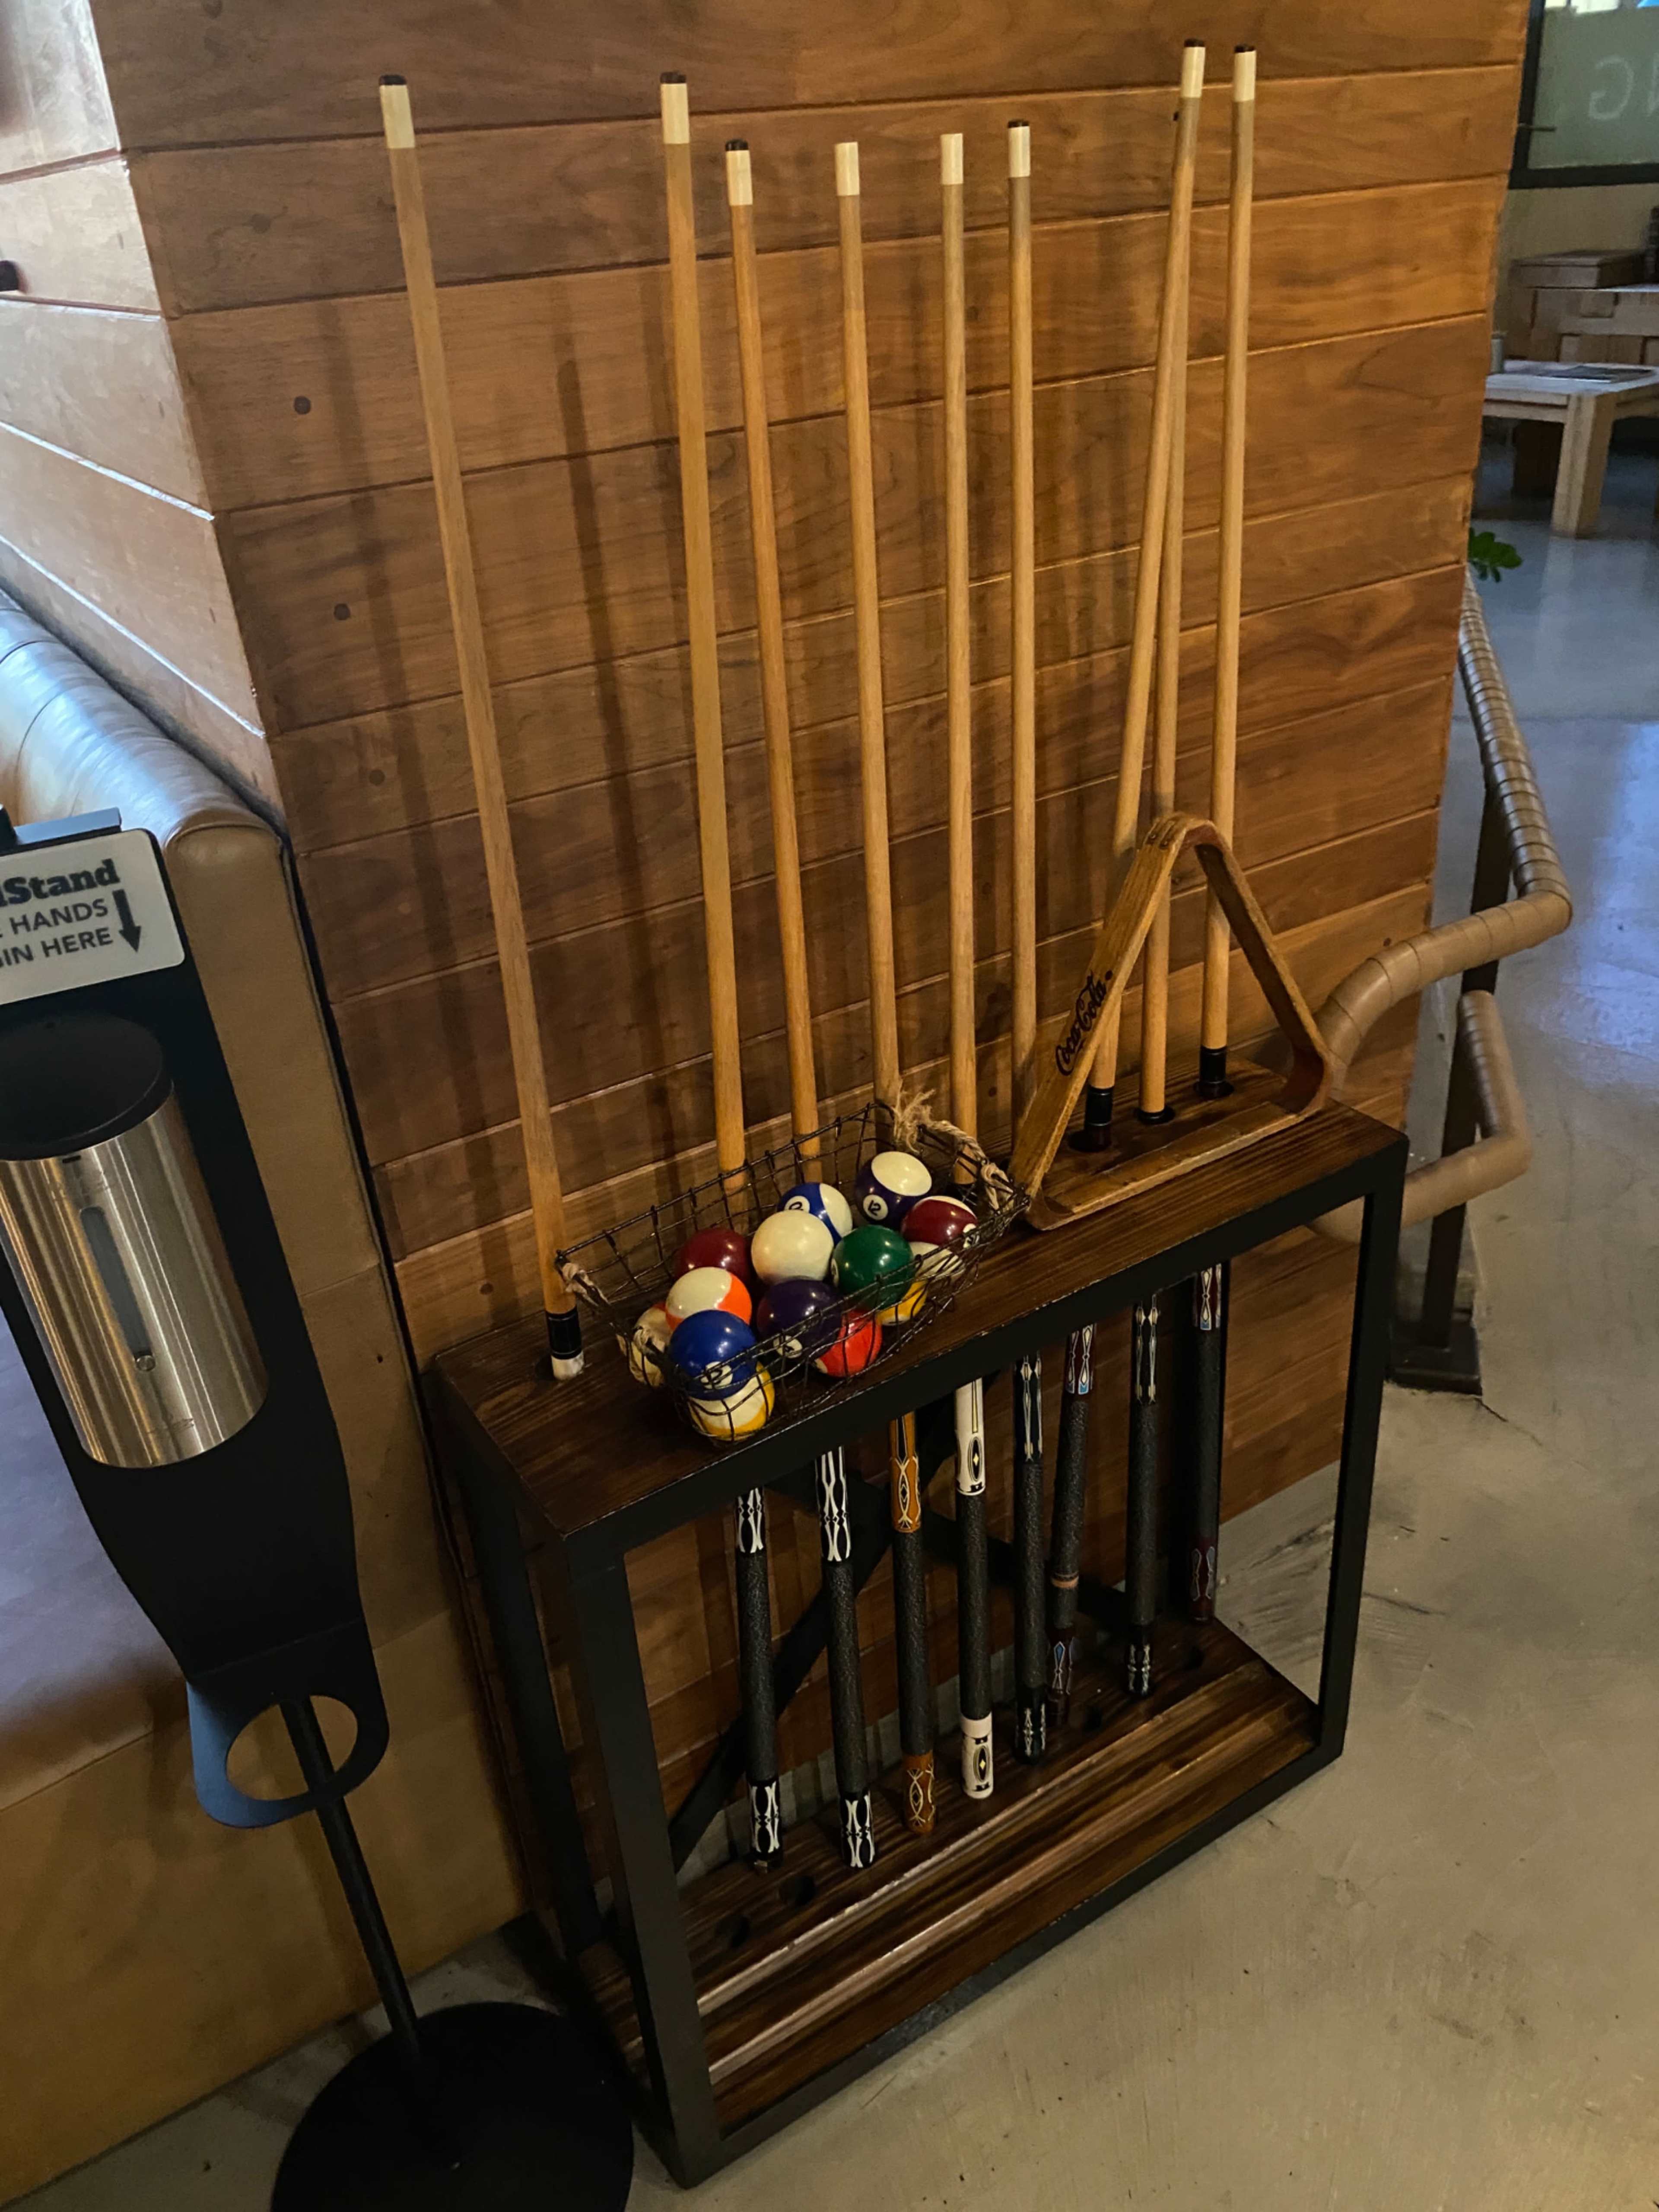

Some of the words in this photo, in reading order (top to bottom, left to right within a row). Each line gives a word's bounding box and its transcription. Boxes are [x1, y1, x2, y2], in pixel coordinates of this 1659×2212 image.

[0, 858, 120, 906] Stand
[10, 898, 108, 934] HANDS
[0, 944, 34, 968] IN
[41, 927, 113, 958] HERE
